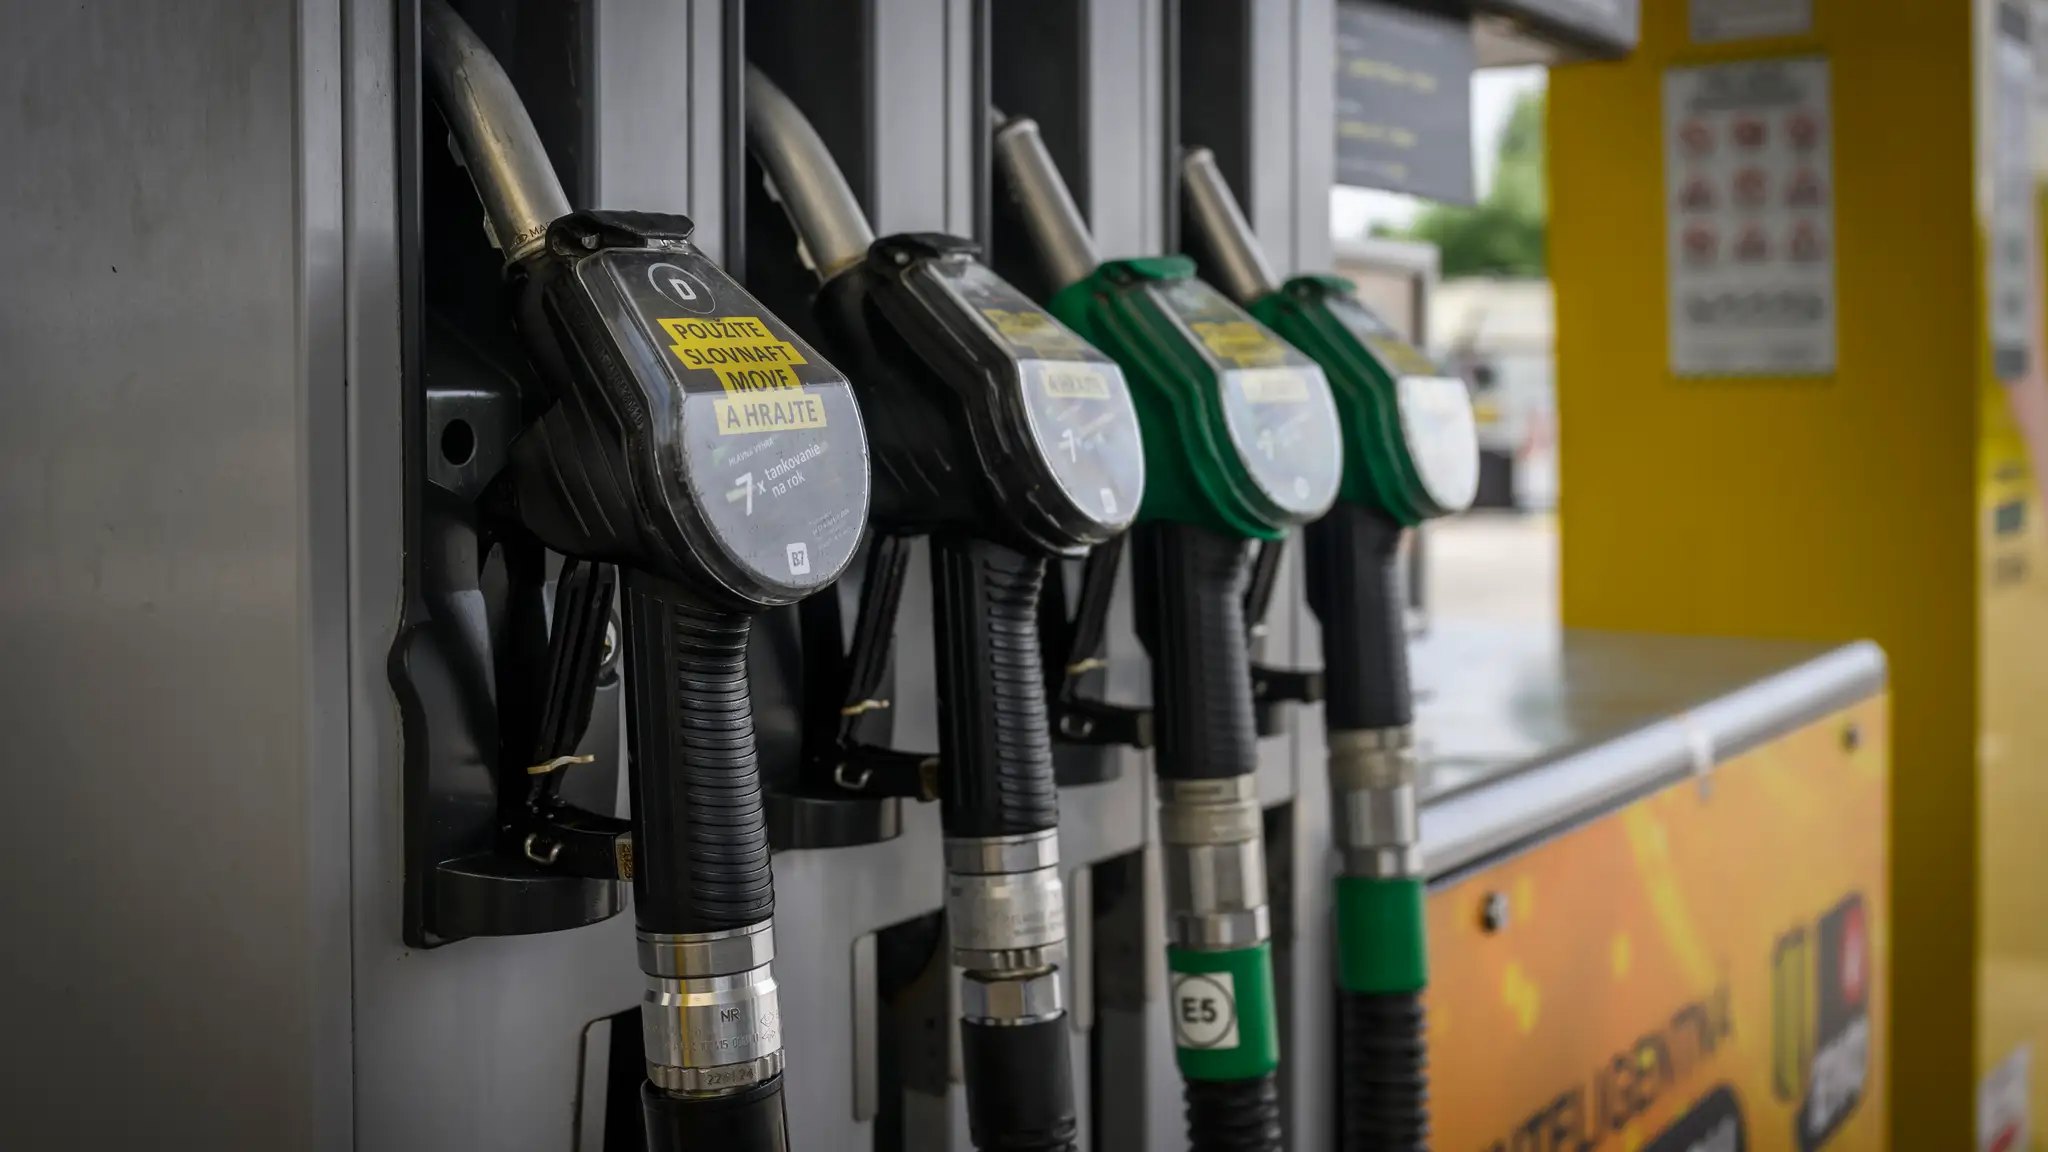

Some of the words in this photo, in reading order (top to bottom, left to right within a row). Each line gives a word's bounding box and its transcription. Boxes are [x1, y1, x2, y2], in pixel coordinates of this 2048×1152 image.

[668, 278, 697, 300] D
[673, 317, 765, 340] POUŽITE
[684, 344, 792, 365] SLOVNAFT
[726, 369, 793, 394] MOVE
[727, 405, 741, 429] A
[744, 400, 818, 427] HRAJTE
[765, 442, 821, 481] tankovanie
[771, 481, 788, 498] na
[787, 471, 806, 489] rok
[791, 551, 805, 567] B7
[721, 1007, 740, 1022] NR
[1181, 997, 1217, 1023] E5
